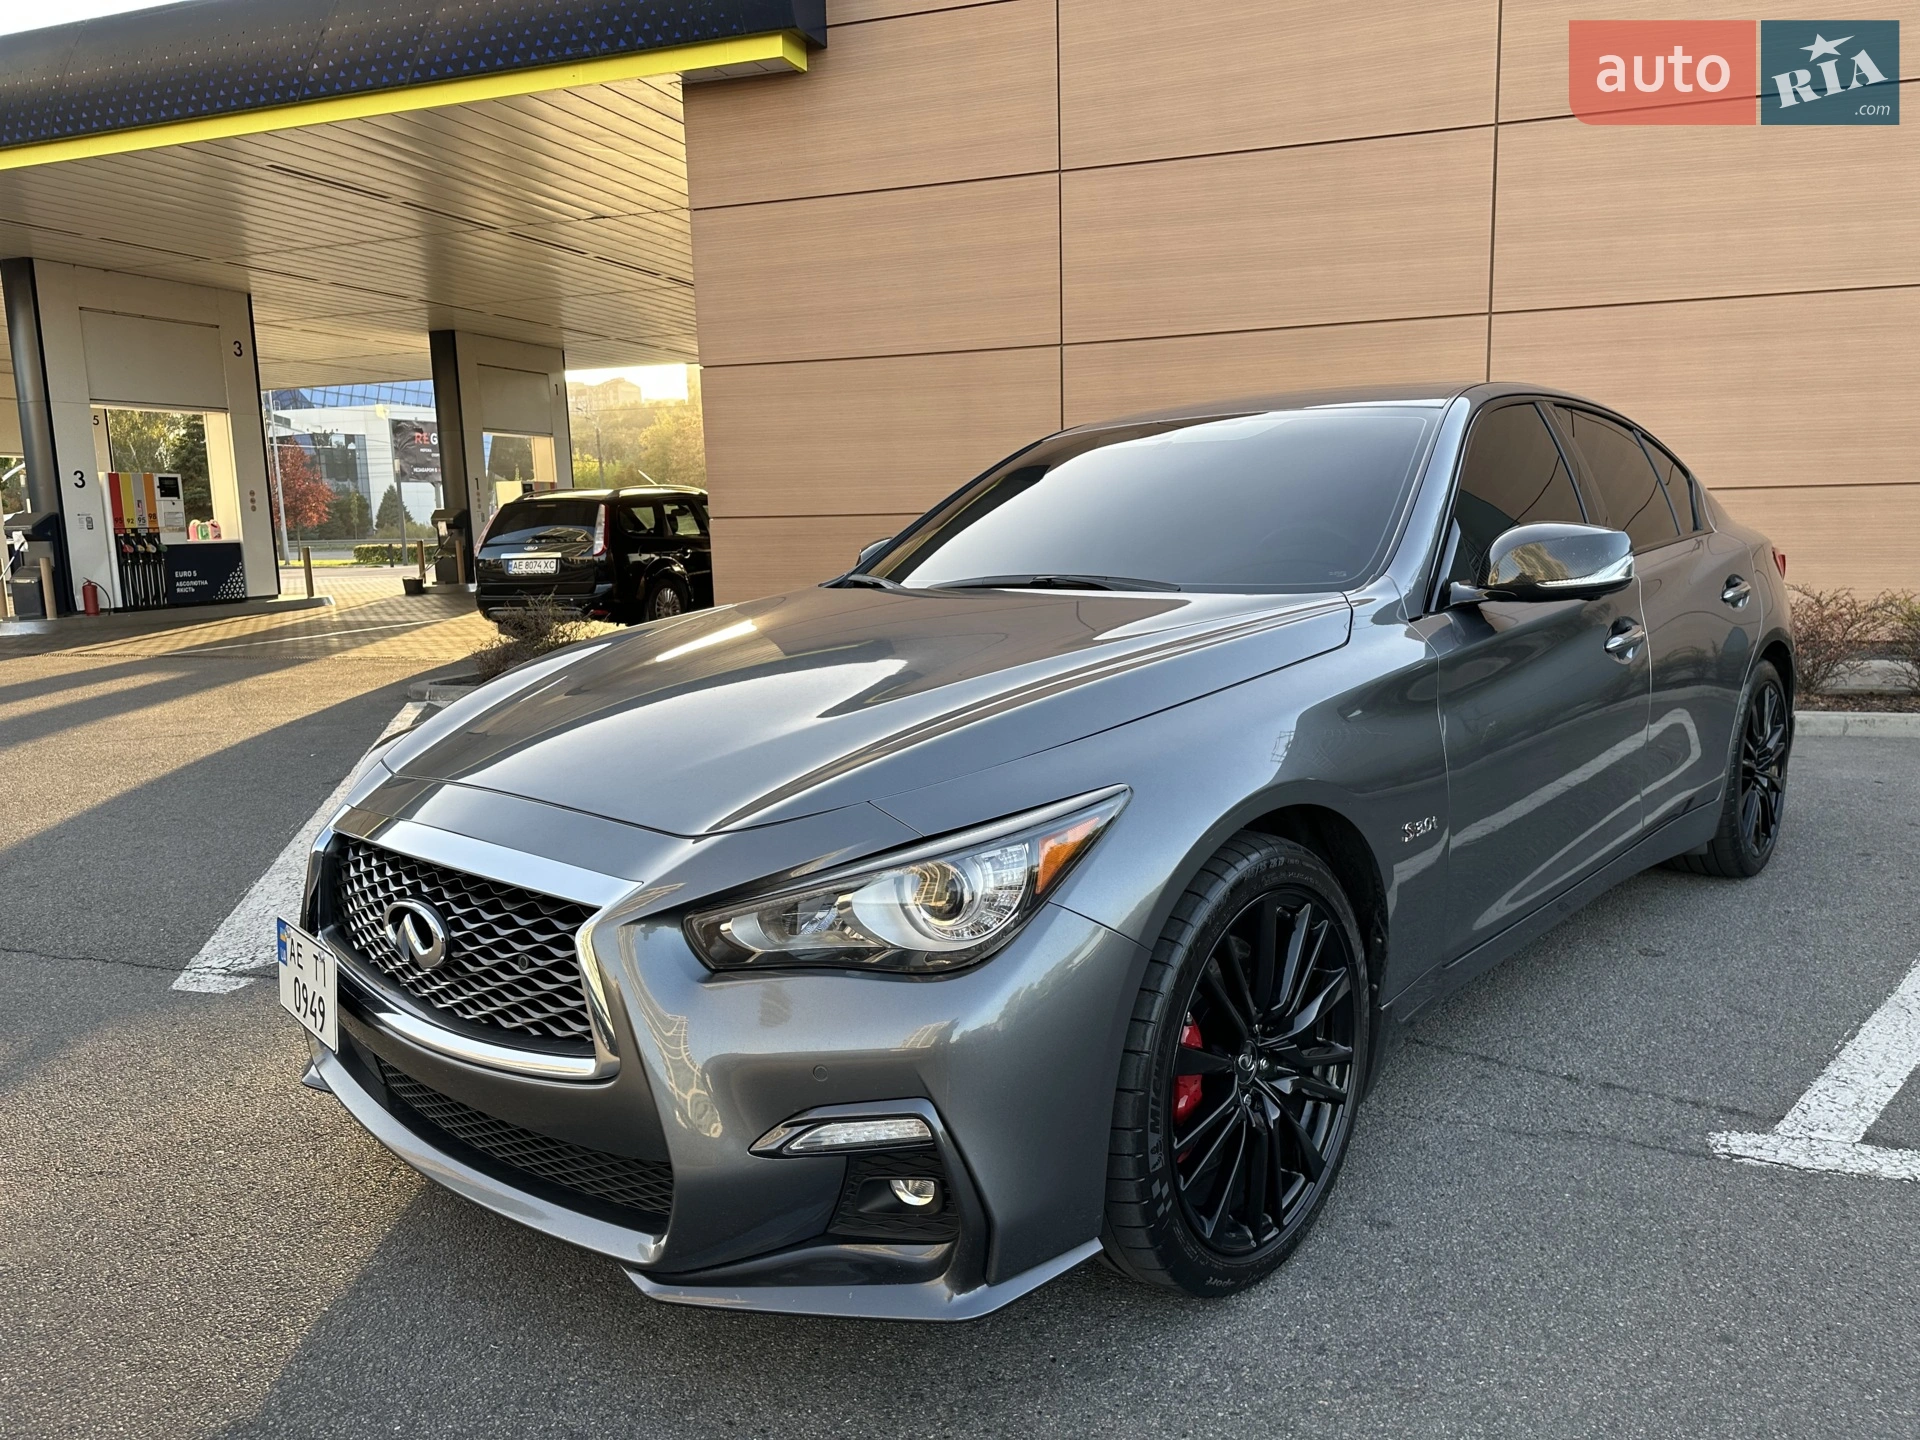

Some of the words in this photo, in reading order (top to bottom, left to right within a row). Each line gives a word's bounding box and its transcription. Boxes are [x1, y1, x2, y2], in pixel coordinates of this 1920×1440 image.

[233, 340, 243, 357] 3
[554, 383, 559, 396] 1
[92, 414, 100, 426] 5
[73, 470, 86, 489] 3
[474, 477, 480, 491] 1
[513, 561, 524, 570] AE
[524, 561, 542, 570] 8074
[543, 560, 555, 570] XC
[174, 570, 192, 578] EURO
[289, 938, 304, 971] AE
[293, 976, 326, 1033] 0949
